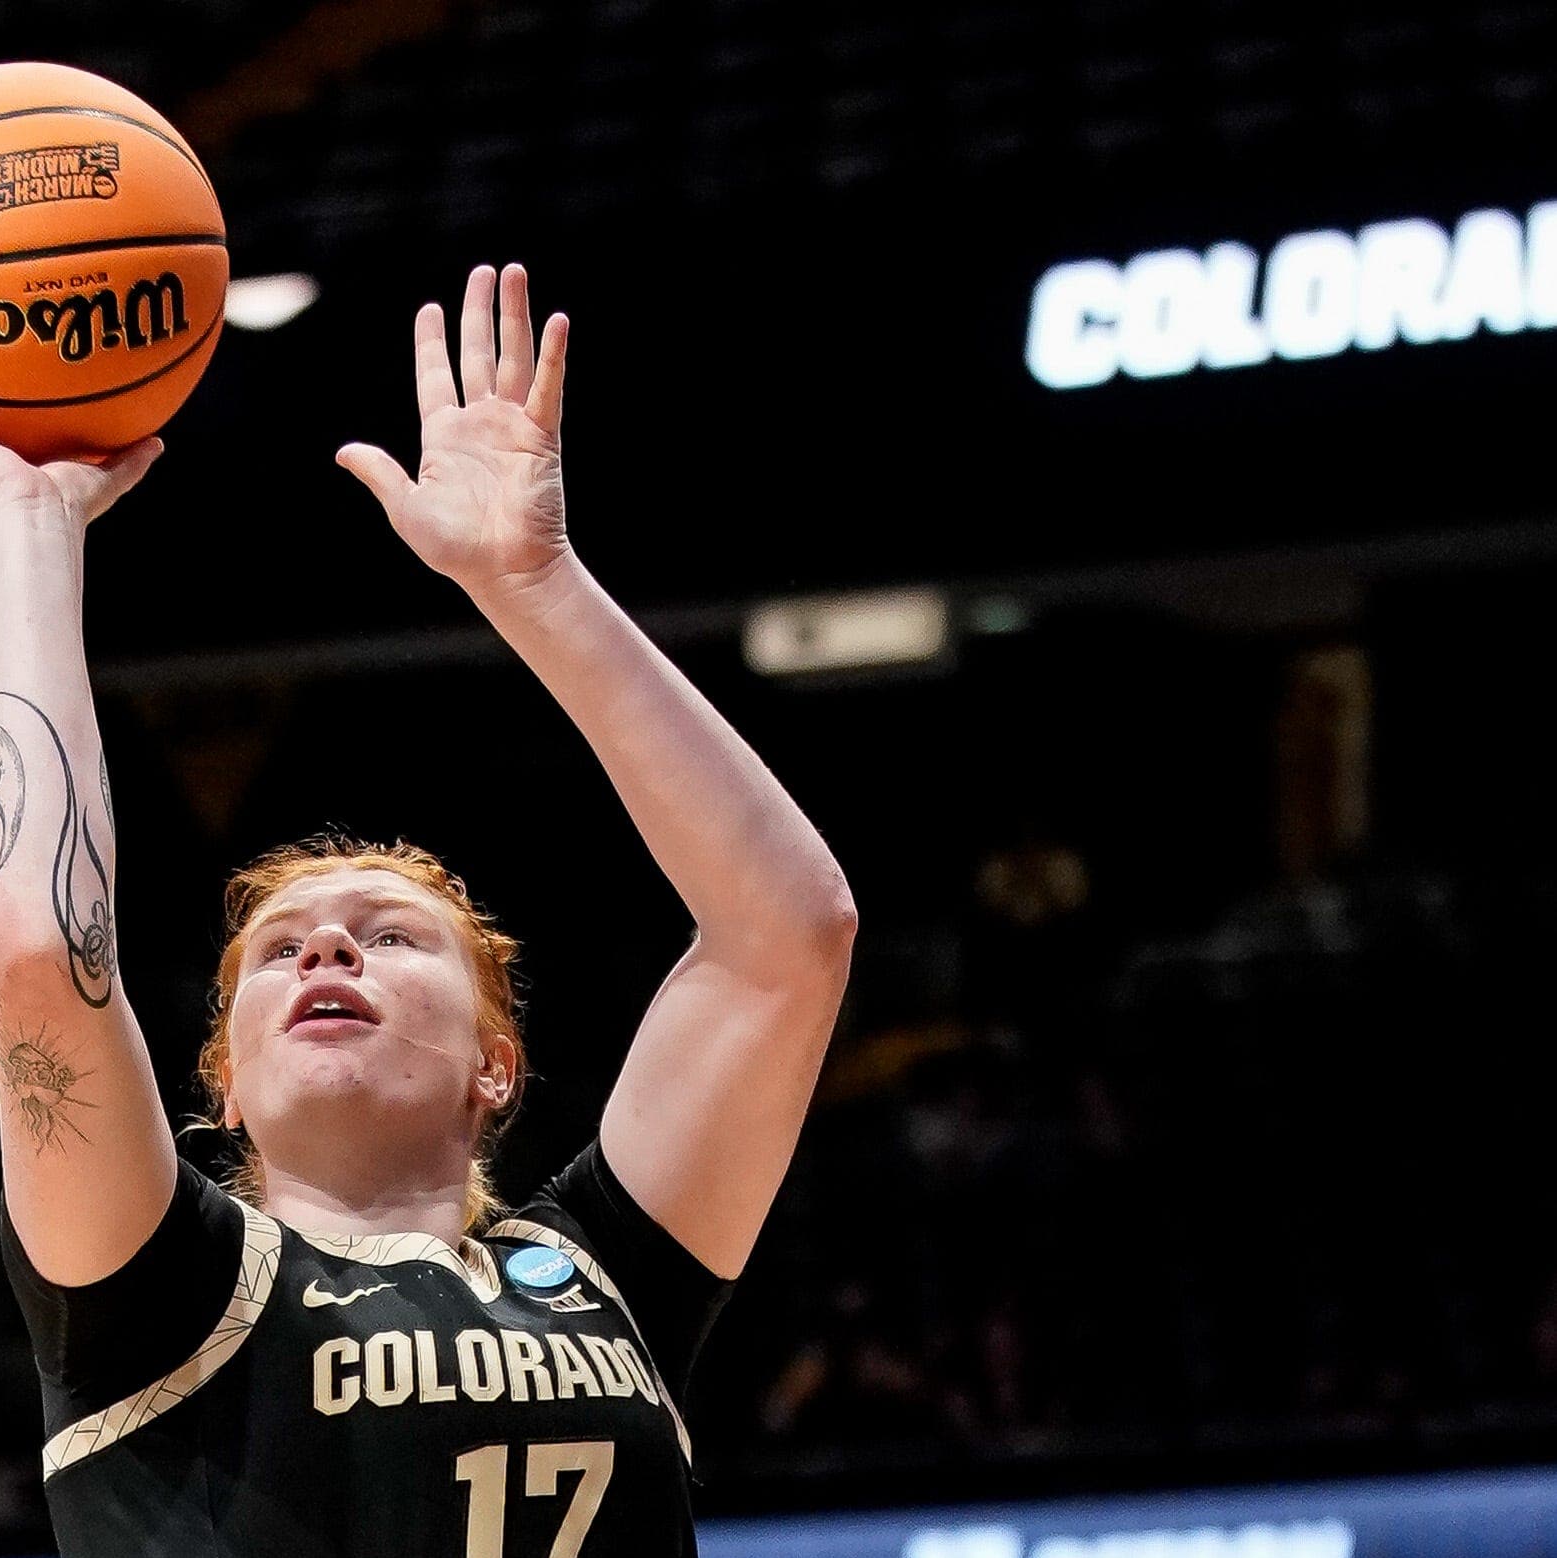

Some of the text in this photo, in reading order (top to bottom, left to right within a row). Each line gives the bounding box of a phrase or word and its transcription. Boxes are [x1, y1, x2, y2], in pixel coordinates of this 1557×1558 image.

[13, 173, 94, 206] MARCH
[23, 272, 109, 293] EVO NXT
[313, 1328, 660, 1416] COLORADO
